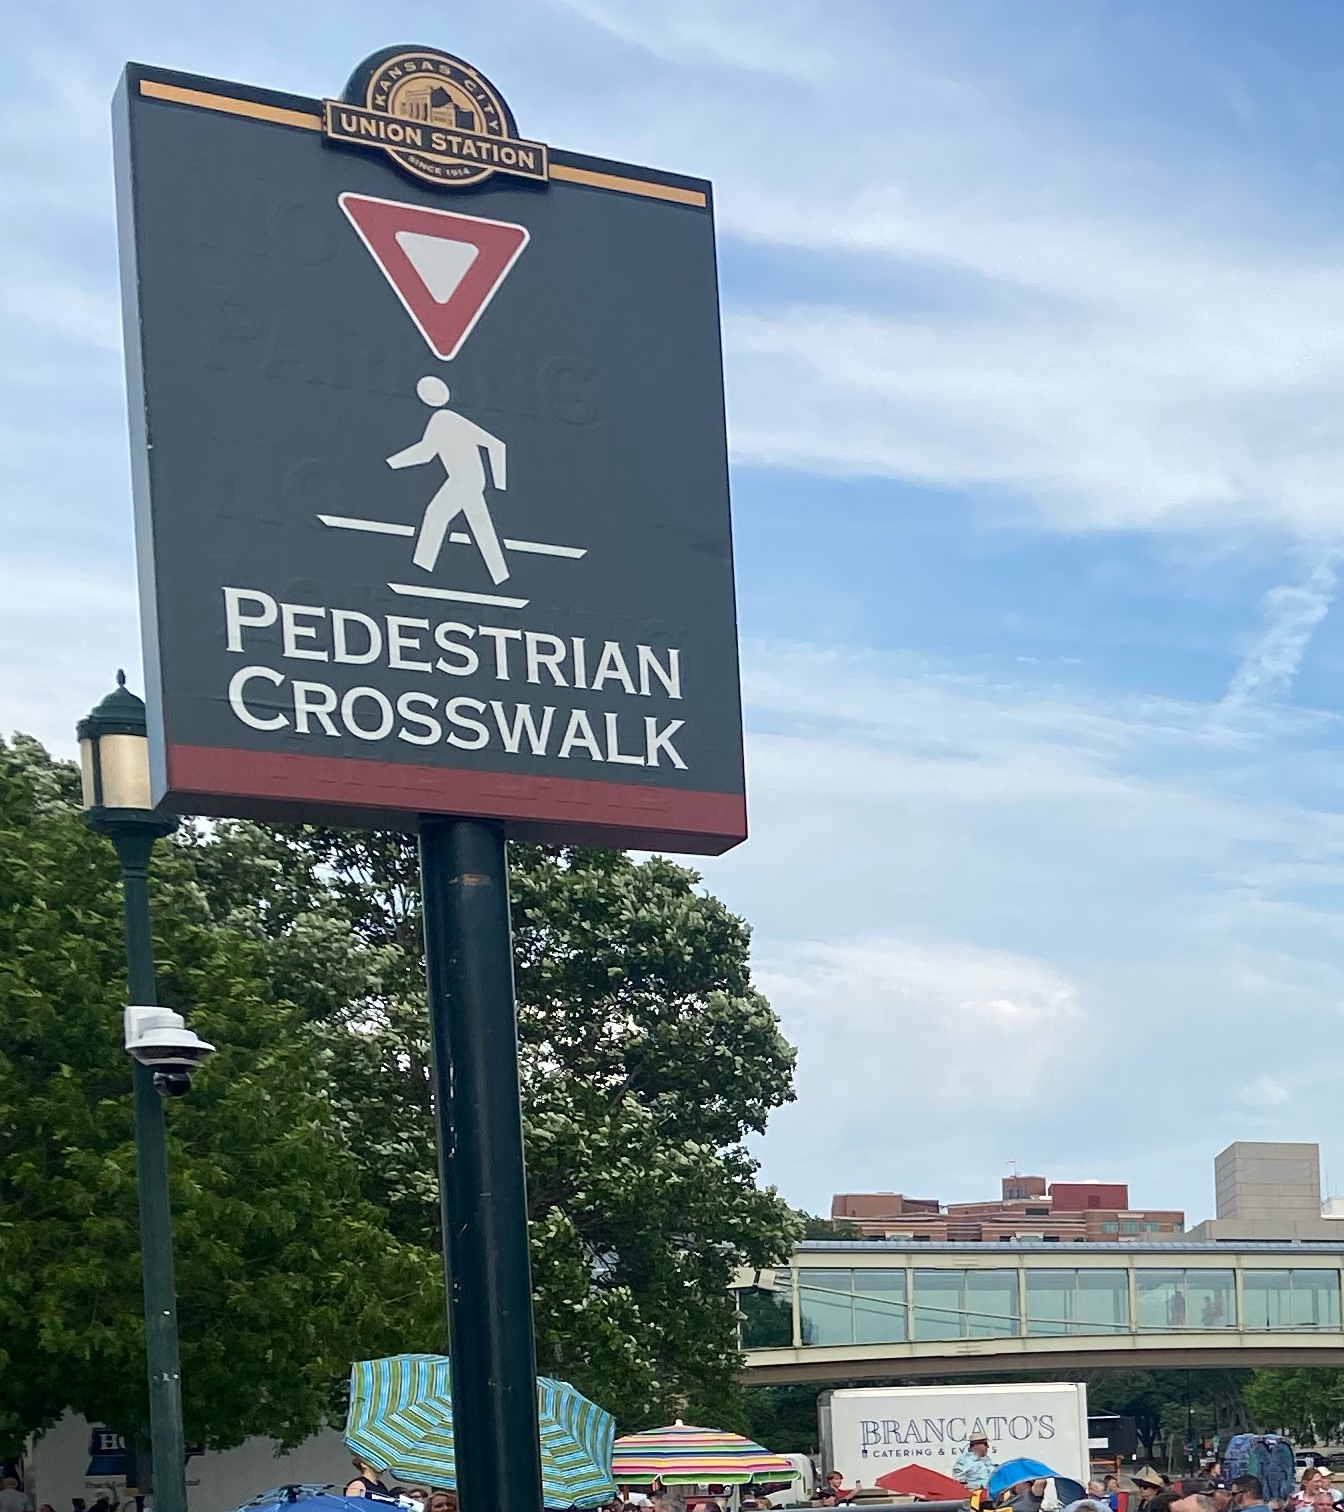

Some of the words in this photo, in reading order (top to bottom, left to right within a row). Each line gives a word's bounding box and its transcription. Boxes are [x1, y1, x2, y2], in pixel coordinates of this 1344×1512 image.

[375, 61, 452, 108] KANSAS
[463, 79, 500, 132] CITY
[340, 112, 422, 146] UNION
[431, 132, 535, 169] STATION
[408, 154, 442, 176] SINCE
[445, 166, 471, 177] 1914
[221, 586, 683, 700] PEDESTRIAN
[227, 665, 689, 770] CROSSWALK
[859, 1415, 1055, 1446] BRANCATO'S
[873, 1448, 932, 1458] CATERING
[938, 1448, 945, 1456] &
